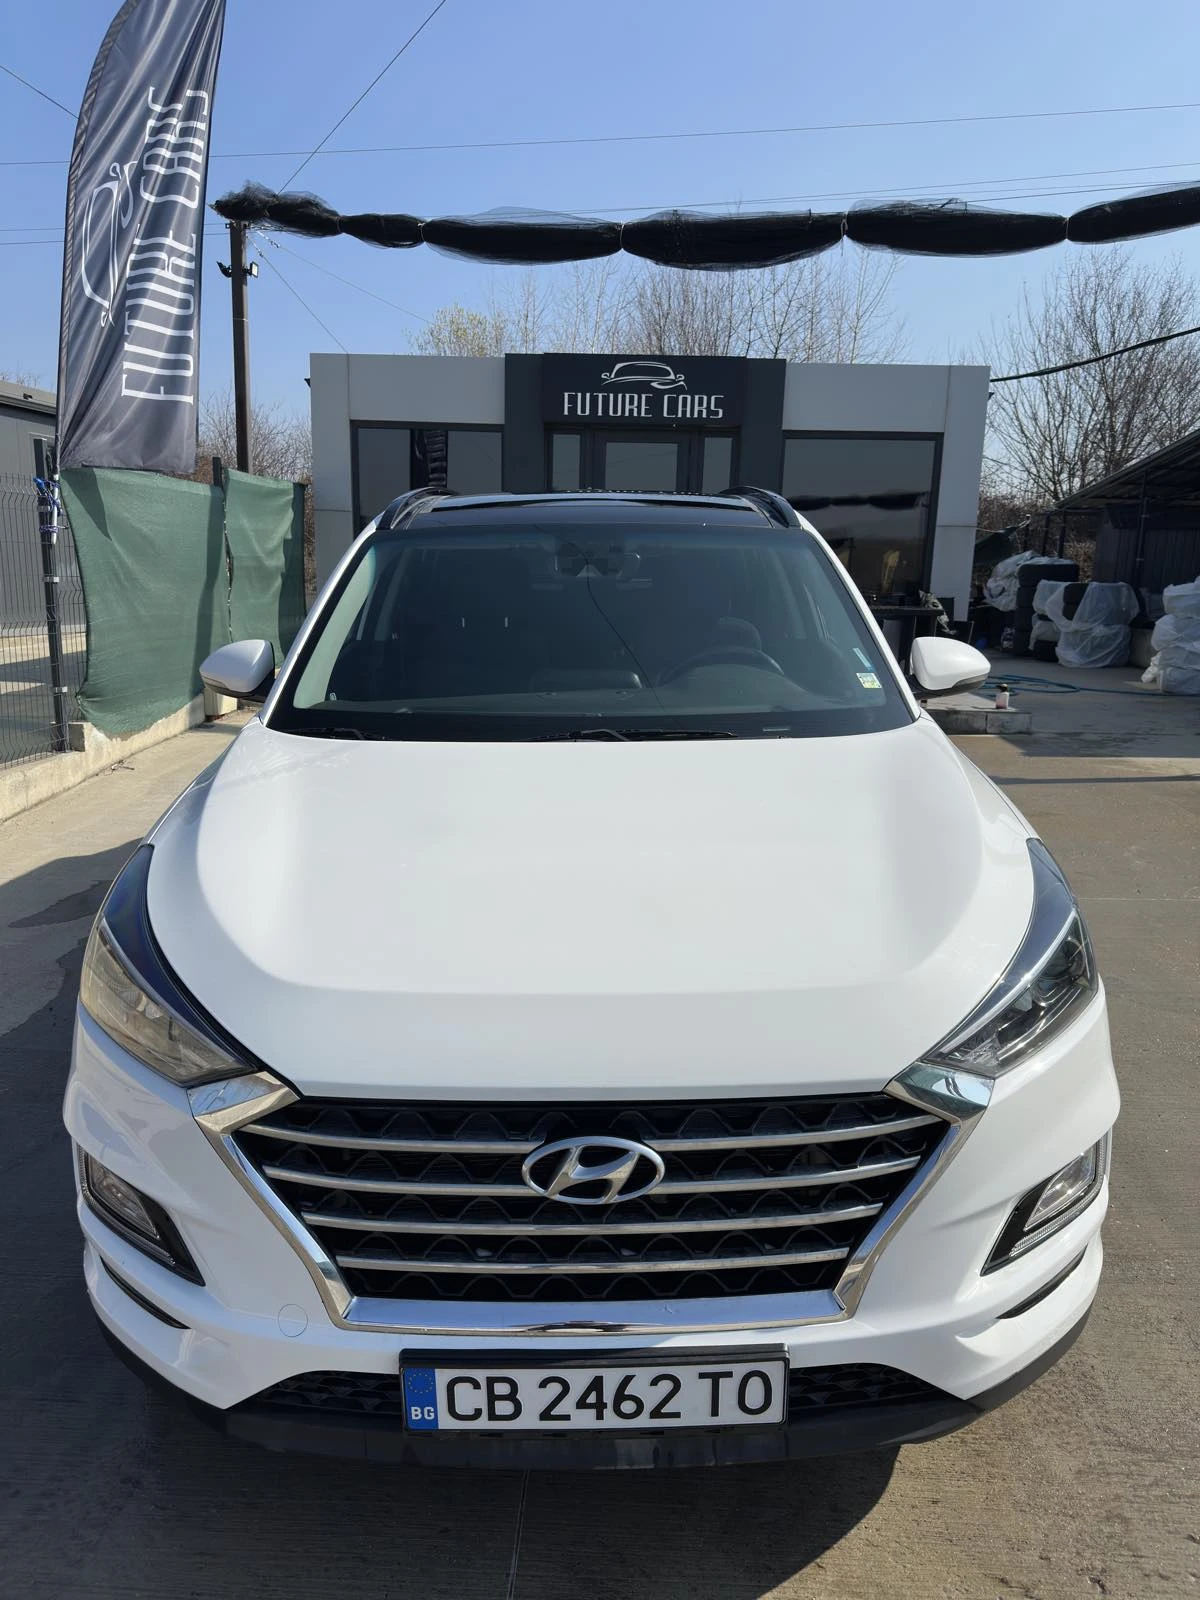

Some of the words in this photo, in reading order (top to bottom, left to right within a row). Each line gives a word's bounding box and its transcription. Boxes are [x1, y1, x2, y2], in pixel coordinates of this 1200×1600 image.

[139, 86, 209, 209] CARS
[121, 223, 198, 406] FUTURE
[563, 392, 653, 417] FUTURE
[663, 394, 724, 419] CARS
[411, 1406, 435, 1420] BG
[446, 1376, 523, 1421] CB
[538, 1373, 682, 1421] 2462
[698, 1369, 773, 1418] TO
